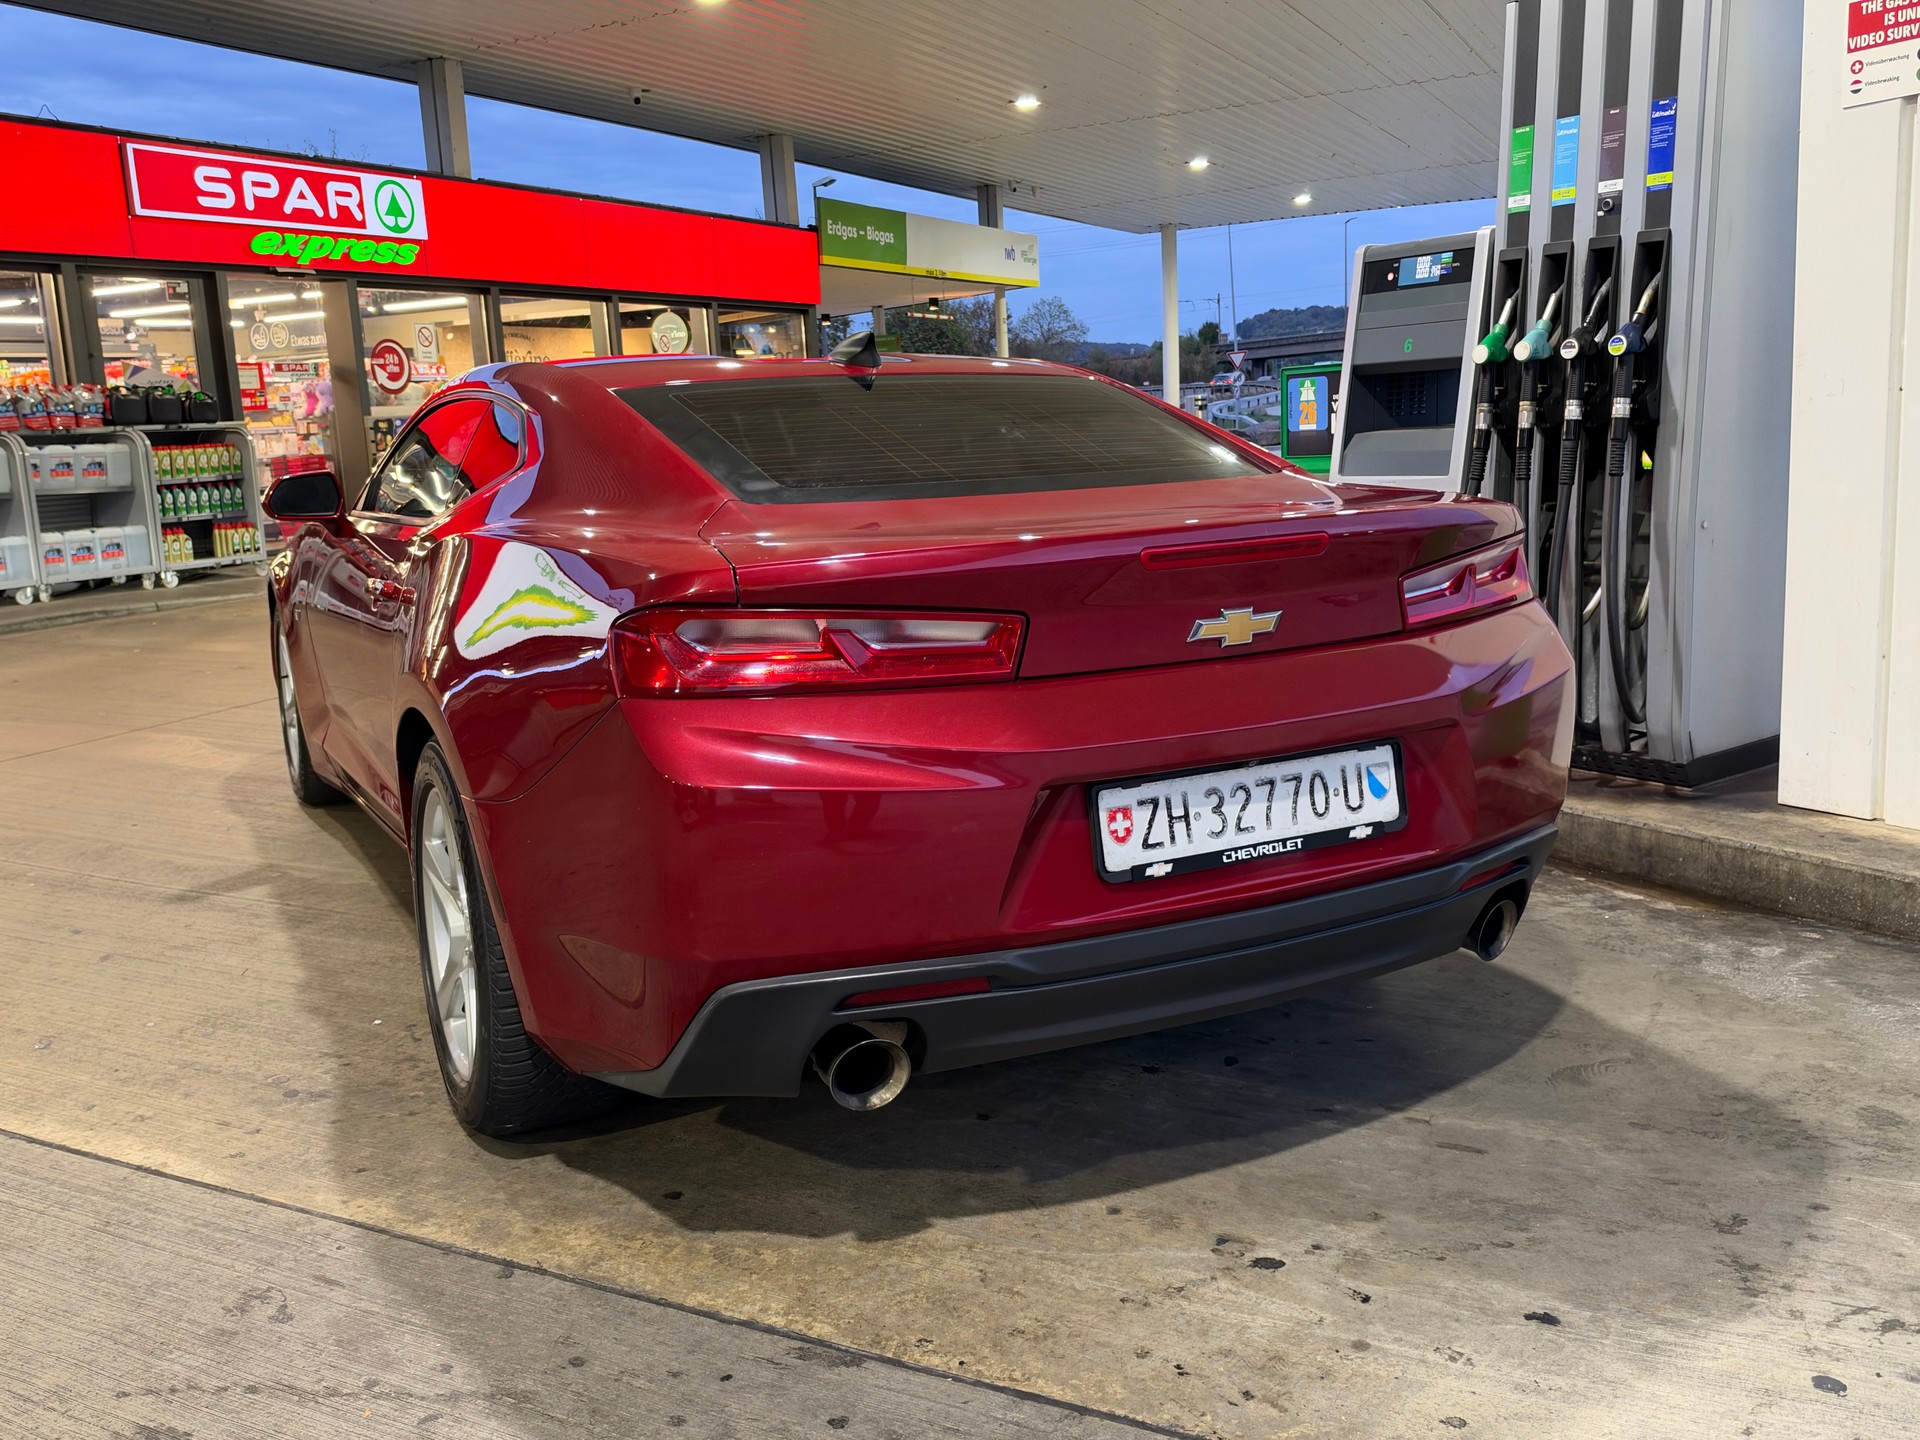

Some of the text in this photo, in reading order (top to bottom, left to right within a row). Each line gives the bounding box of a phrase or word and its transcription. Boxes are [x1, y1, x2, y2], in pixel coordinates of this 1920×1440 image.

[1861, 0, 1883, 15] THE
[1884, 11, 1895, 26] IS
[1848, 30, 1885, 50] VIDEO
[194, 165, 364, 222] SPAR
[827, 219, 858, 241] Erdgas
[866, 225, 895, 246] Biogas
[250, 231, 420, 265] express
[290, 334, 310, 347] Etwas
[1404, 338, 1414, 354] 6
[281, 363, 310, 373] SPAR
[384, 353, 394, 365] 24
[1299, 401, 1317, 425] 26
[1222, 837, 1304, 863] CHEVROLET
